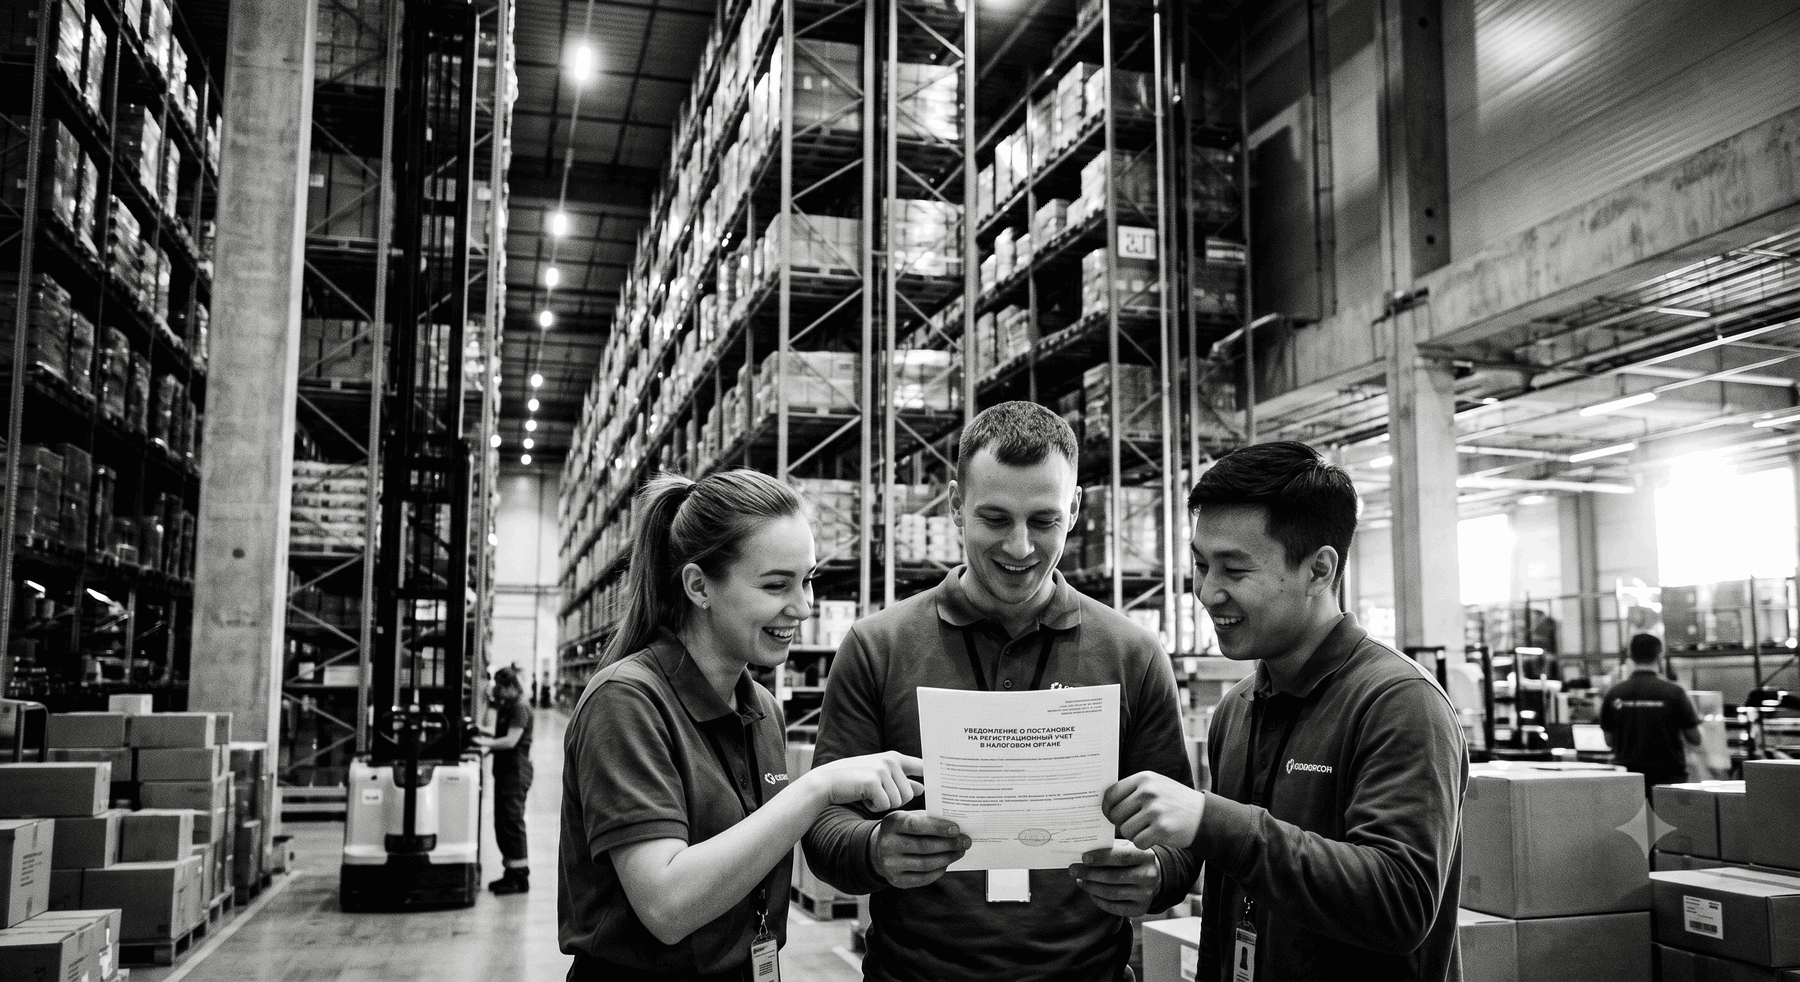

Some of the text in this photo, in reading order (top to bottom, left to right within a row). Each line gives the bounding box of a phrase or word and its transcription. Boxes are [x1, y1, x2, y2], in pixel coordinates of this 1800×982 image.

[963, 727, 1018, 735] УВЕДОМЛЕНИЕ
[1026, 726, 1076, 734] ПОСТАНОВКЕ
[979, 734, 1053, 742] РЕГИСТРАЦИОННЫЙ
